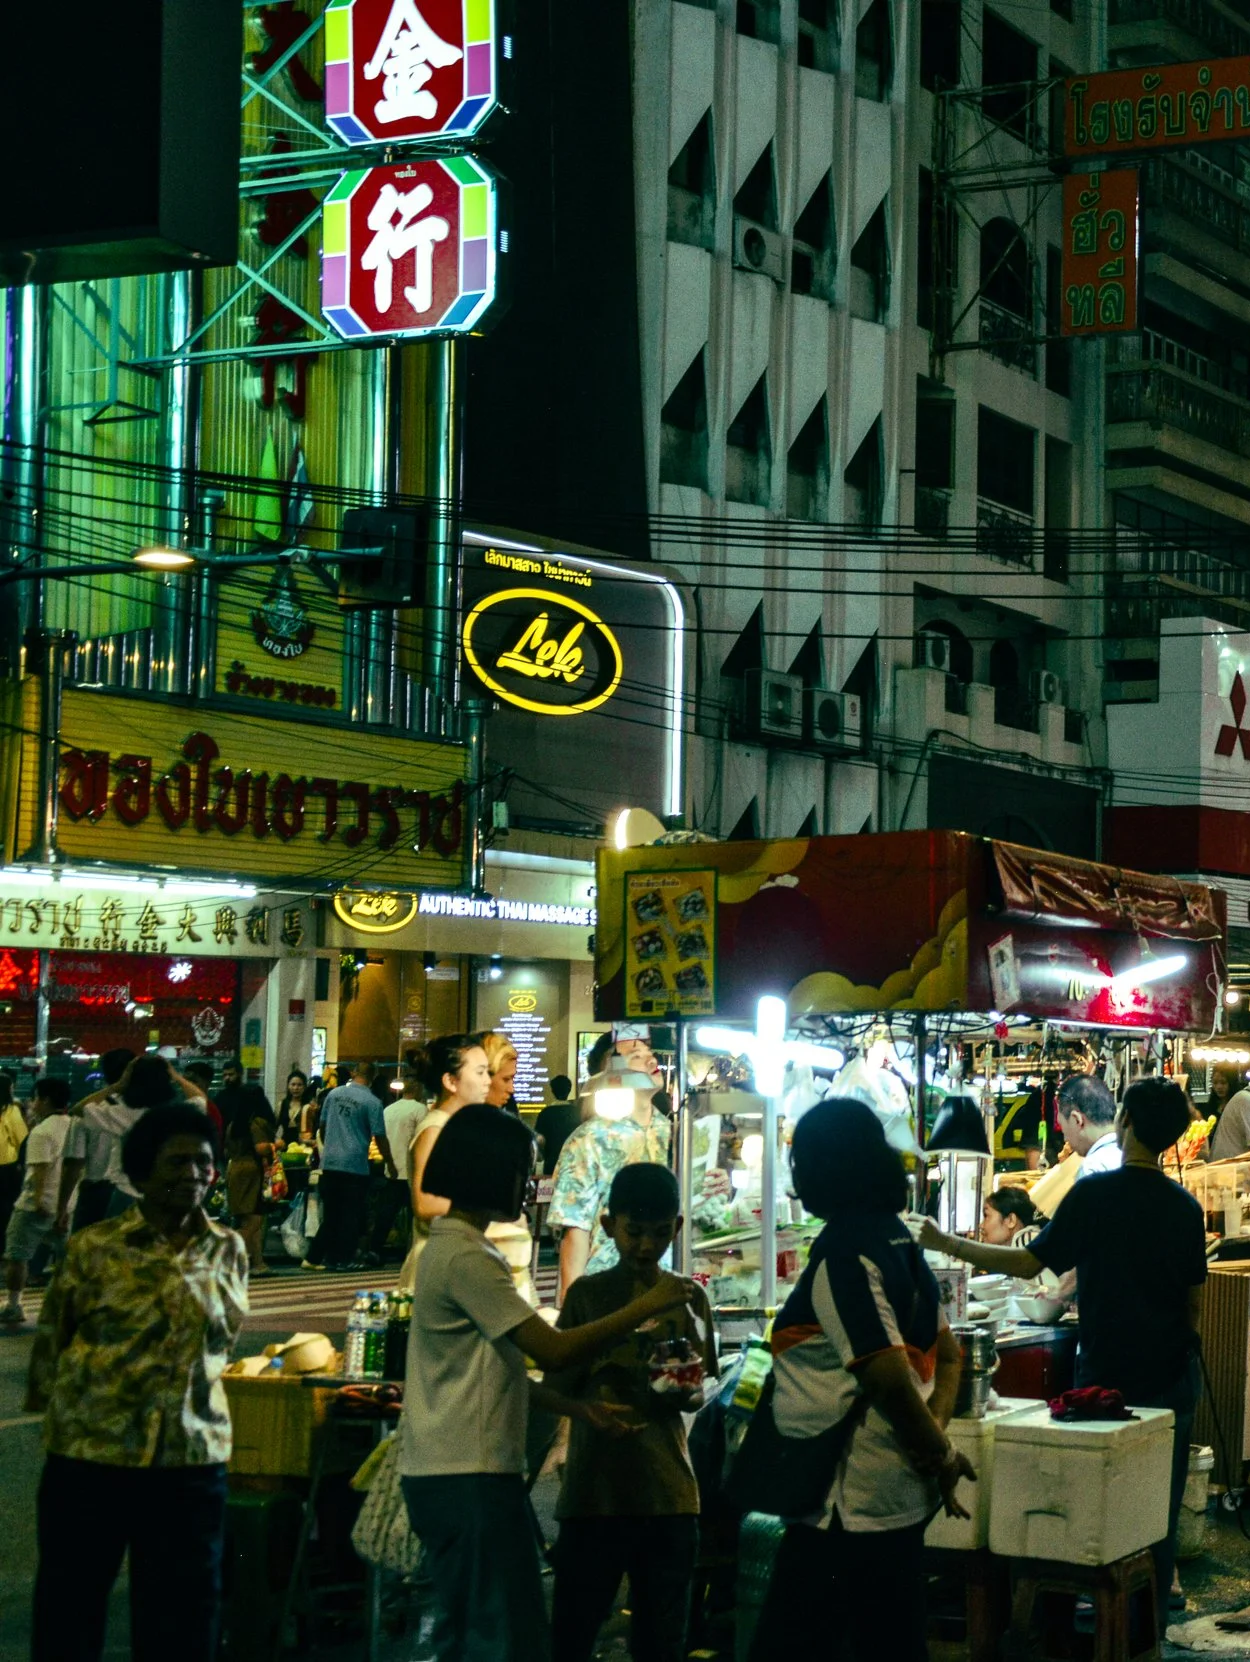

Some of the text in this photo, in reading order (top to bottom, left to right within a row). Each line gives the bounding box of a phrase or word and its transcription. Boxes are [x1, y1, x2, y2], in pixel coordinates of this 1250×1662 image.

[496, 612, 586, 683] Lek
[419, 893, 496, 918] AUTHENTIC
[496, 900, 528, 921] THAI
[528, 903, 589, 926] MASSAGE
